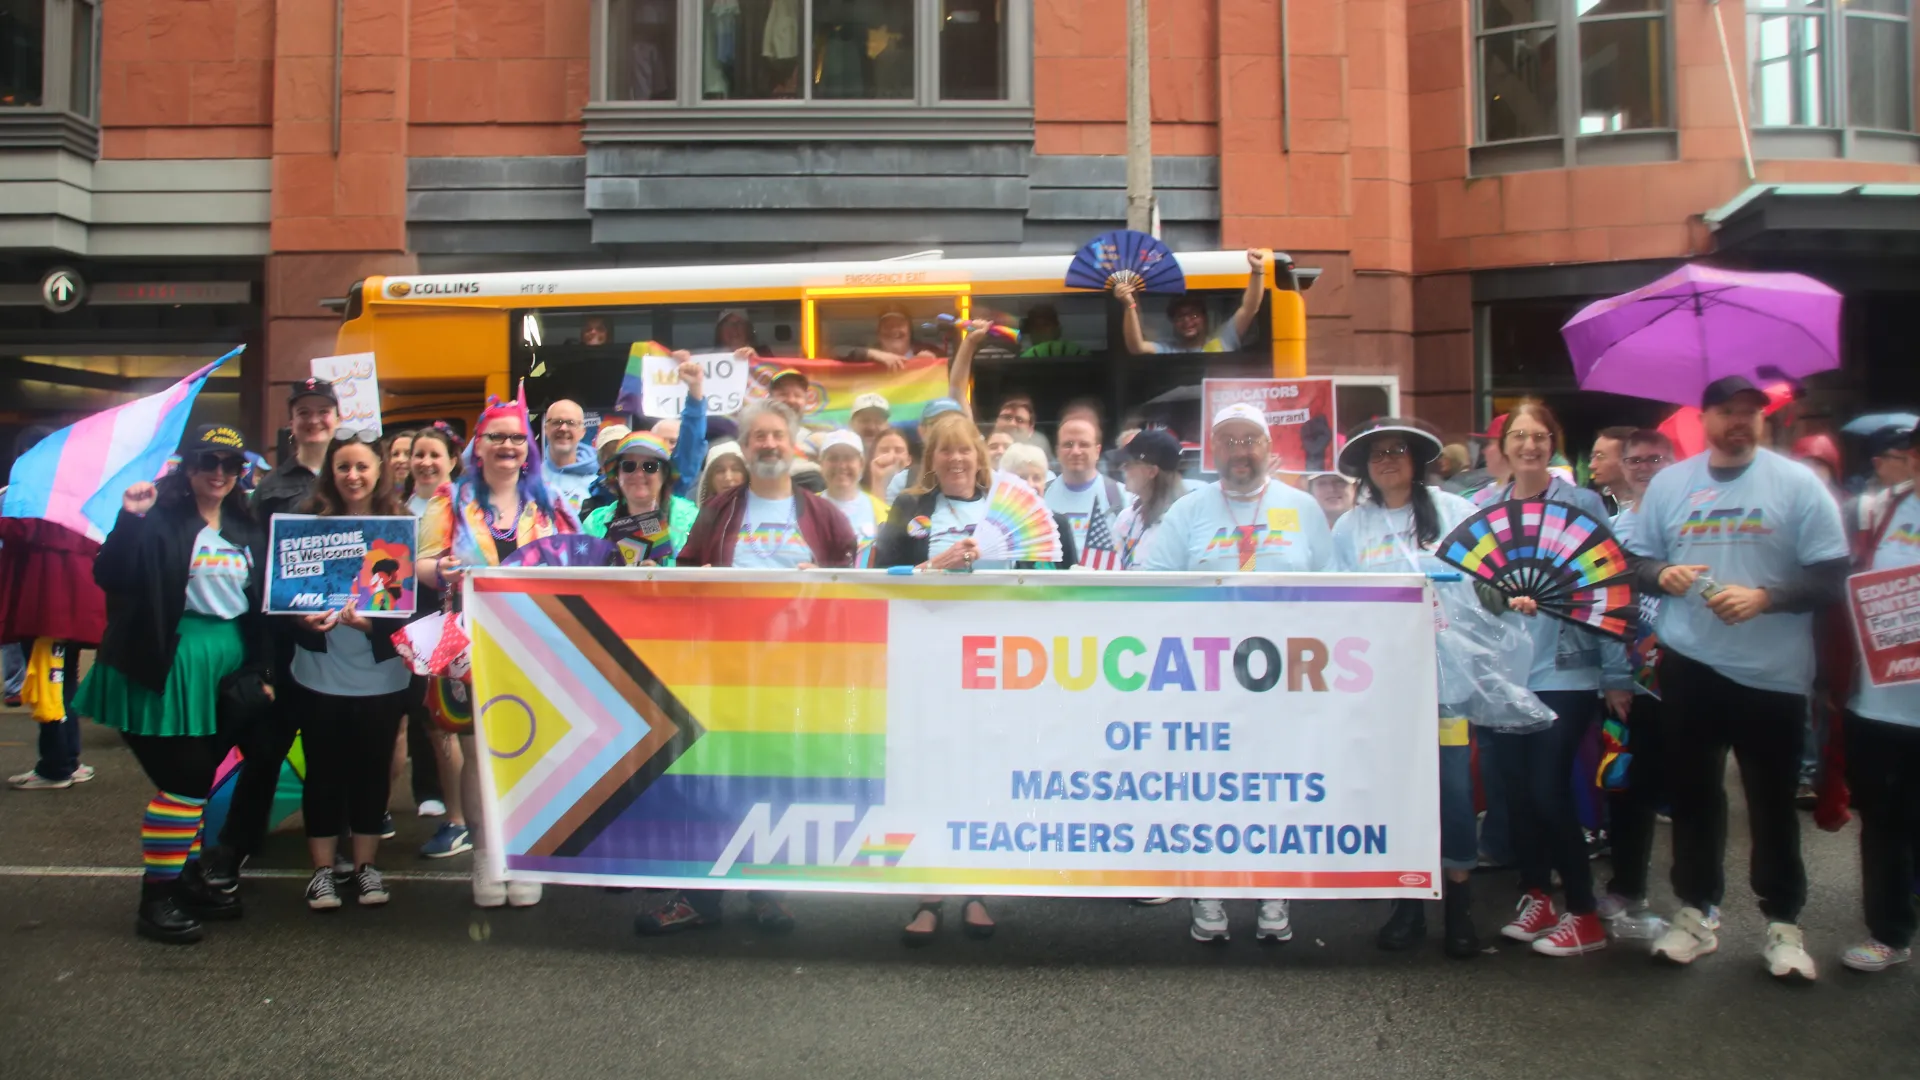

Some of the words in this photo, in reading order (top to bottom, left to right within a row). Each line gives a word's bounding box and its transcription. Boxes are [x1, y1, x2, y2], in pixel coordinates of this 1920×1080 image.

[414, 282, 480, 294] COLLINS
[656, 392, 740, 415] KIGS
[1213, 384, 1299, 401] EDUCATORS
[280, 531, 364, 552] EVERYONE
[285, 551, 298, 563] Is
[300, 546, 364, 562] Welcome
[286, 564, 320, 576] Here
[288, 592, 327, 607] MTA
[1857, 573, 1920, 602] EDUCA
[1861, 590, 1920, 617] UNITE
[961, 635, 1375, 692] EDUCATORS
[1104, 721, 1152, 751] OF
[1162, 721, 1231, 752] THE
[1010, 769, 1326, 803] MASSACHUSETTS
[708, 802, 917, 877] MTA
[946, 820, 1134, 855] TEACHERS
[1143, 822, 1388, 855] ASSOCIATION
